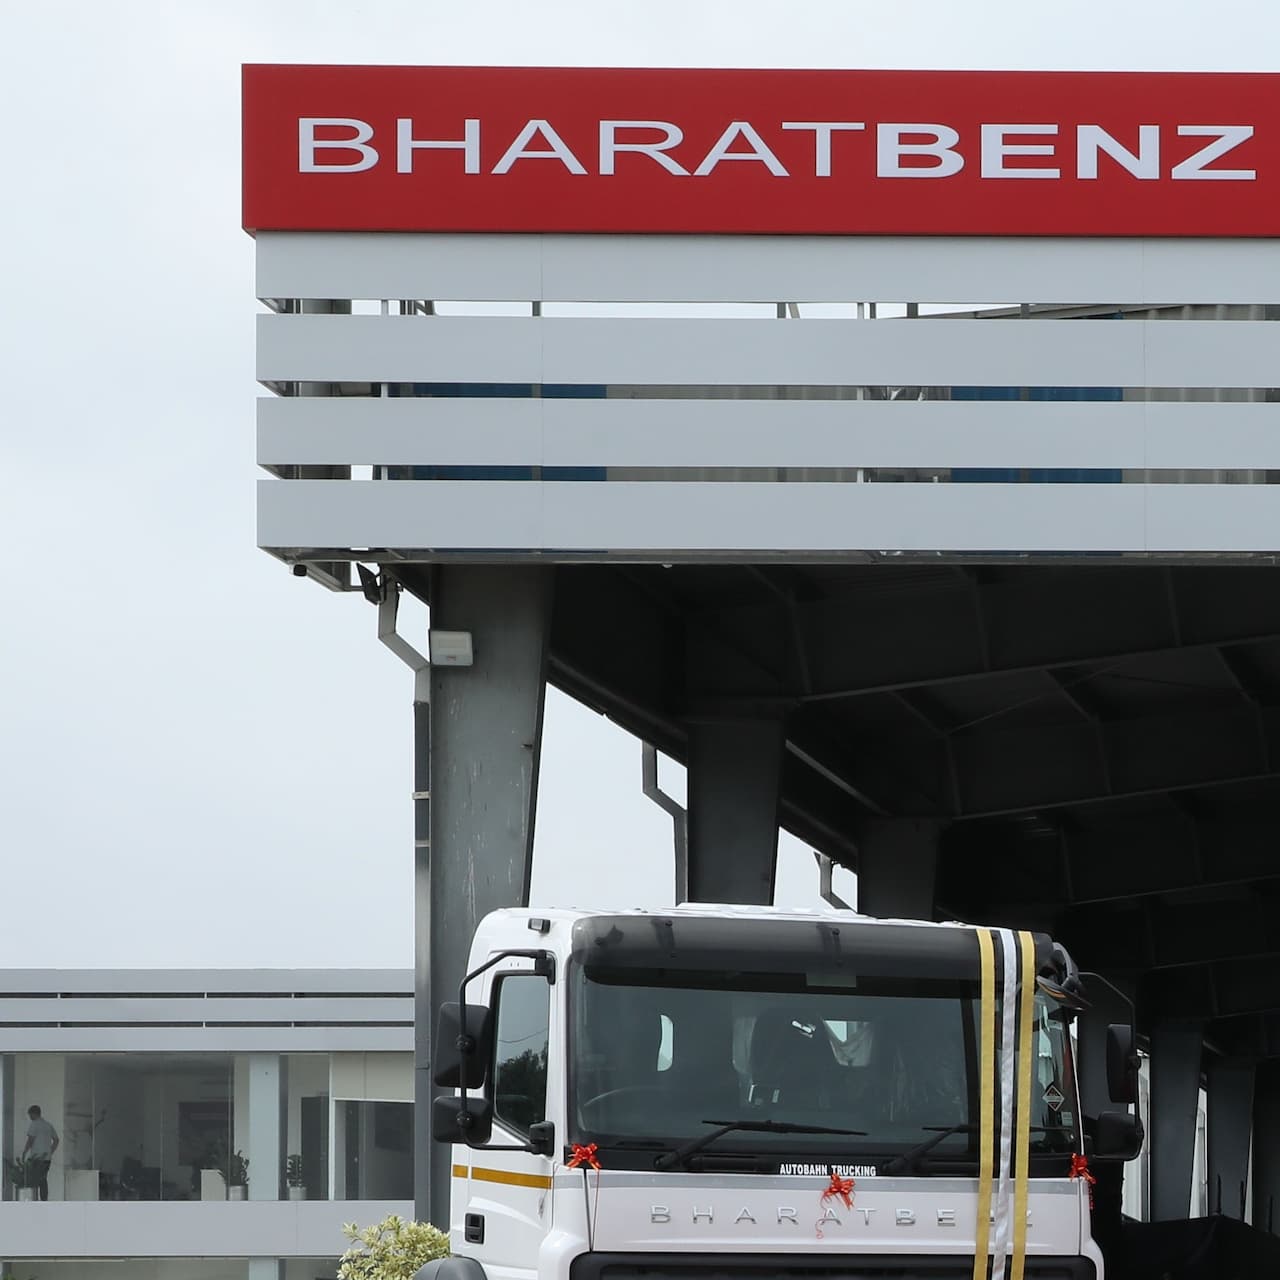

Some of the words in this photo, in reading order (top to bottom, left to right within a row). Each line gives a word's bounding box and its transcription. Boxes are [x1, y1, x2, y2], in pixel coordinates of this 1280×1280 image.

[297, 117, 1257, 181] BHARATBENZ
[779, 1164, 828, 1175] AUTOBAHN
[831, 1165, 877, 1177] TRUCKING
[651, 1205, 1033, 1227] BHARATBE
